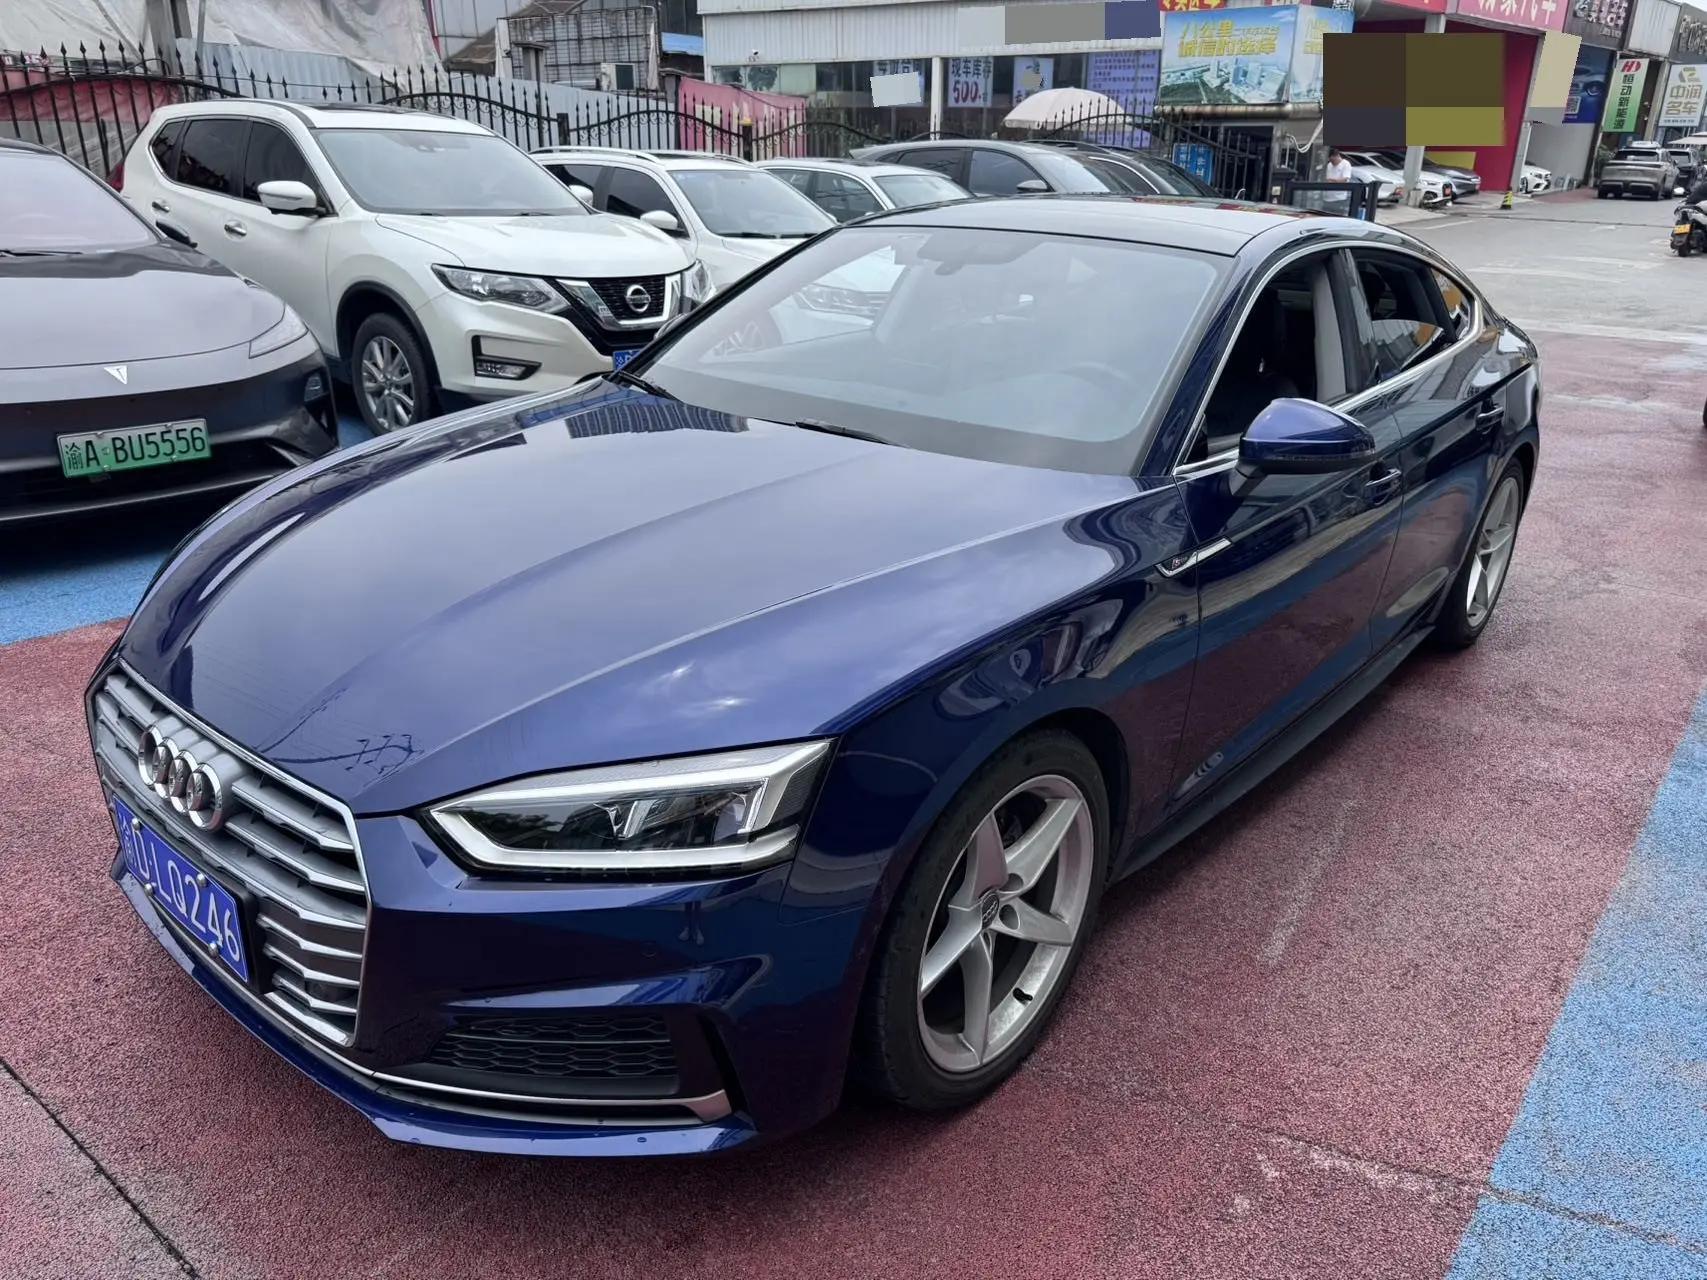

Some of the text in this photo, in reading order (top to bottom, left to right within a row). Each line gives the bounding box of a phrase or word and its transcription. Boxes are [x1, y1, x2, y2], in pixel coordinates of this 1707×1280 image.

[951, 57, 992, 79] 现车库存
[1669, 84, 1703, 100] 中润
[1664, 101, 1698, 116] 名车
